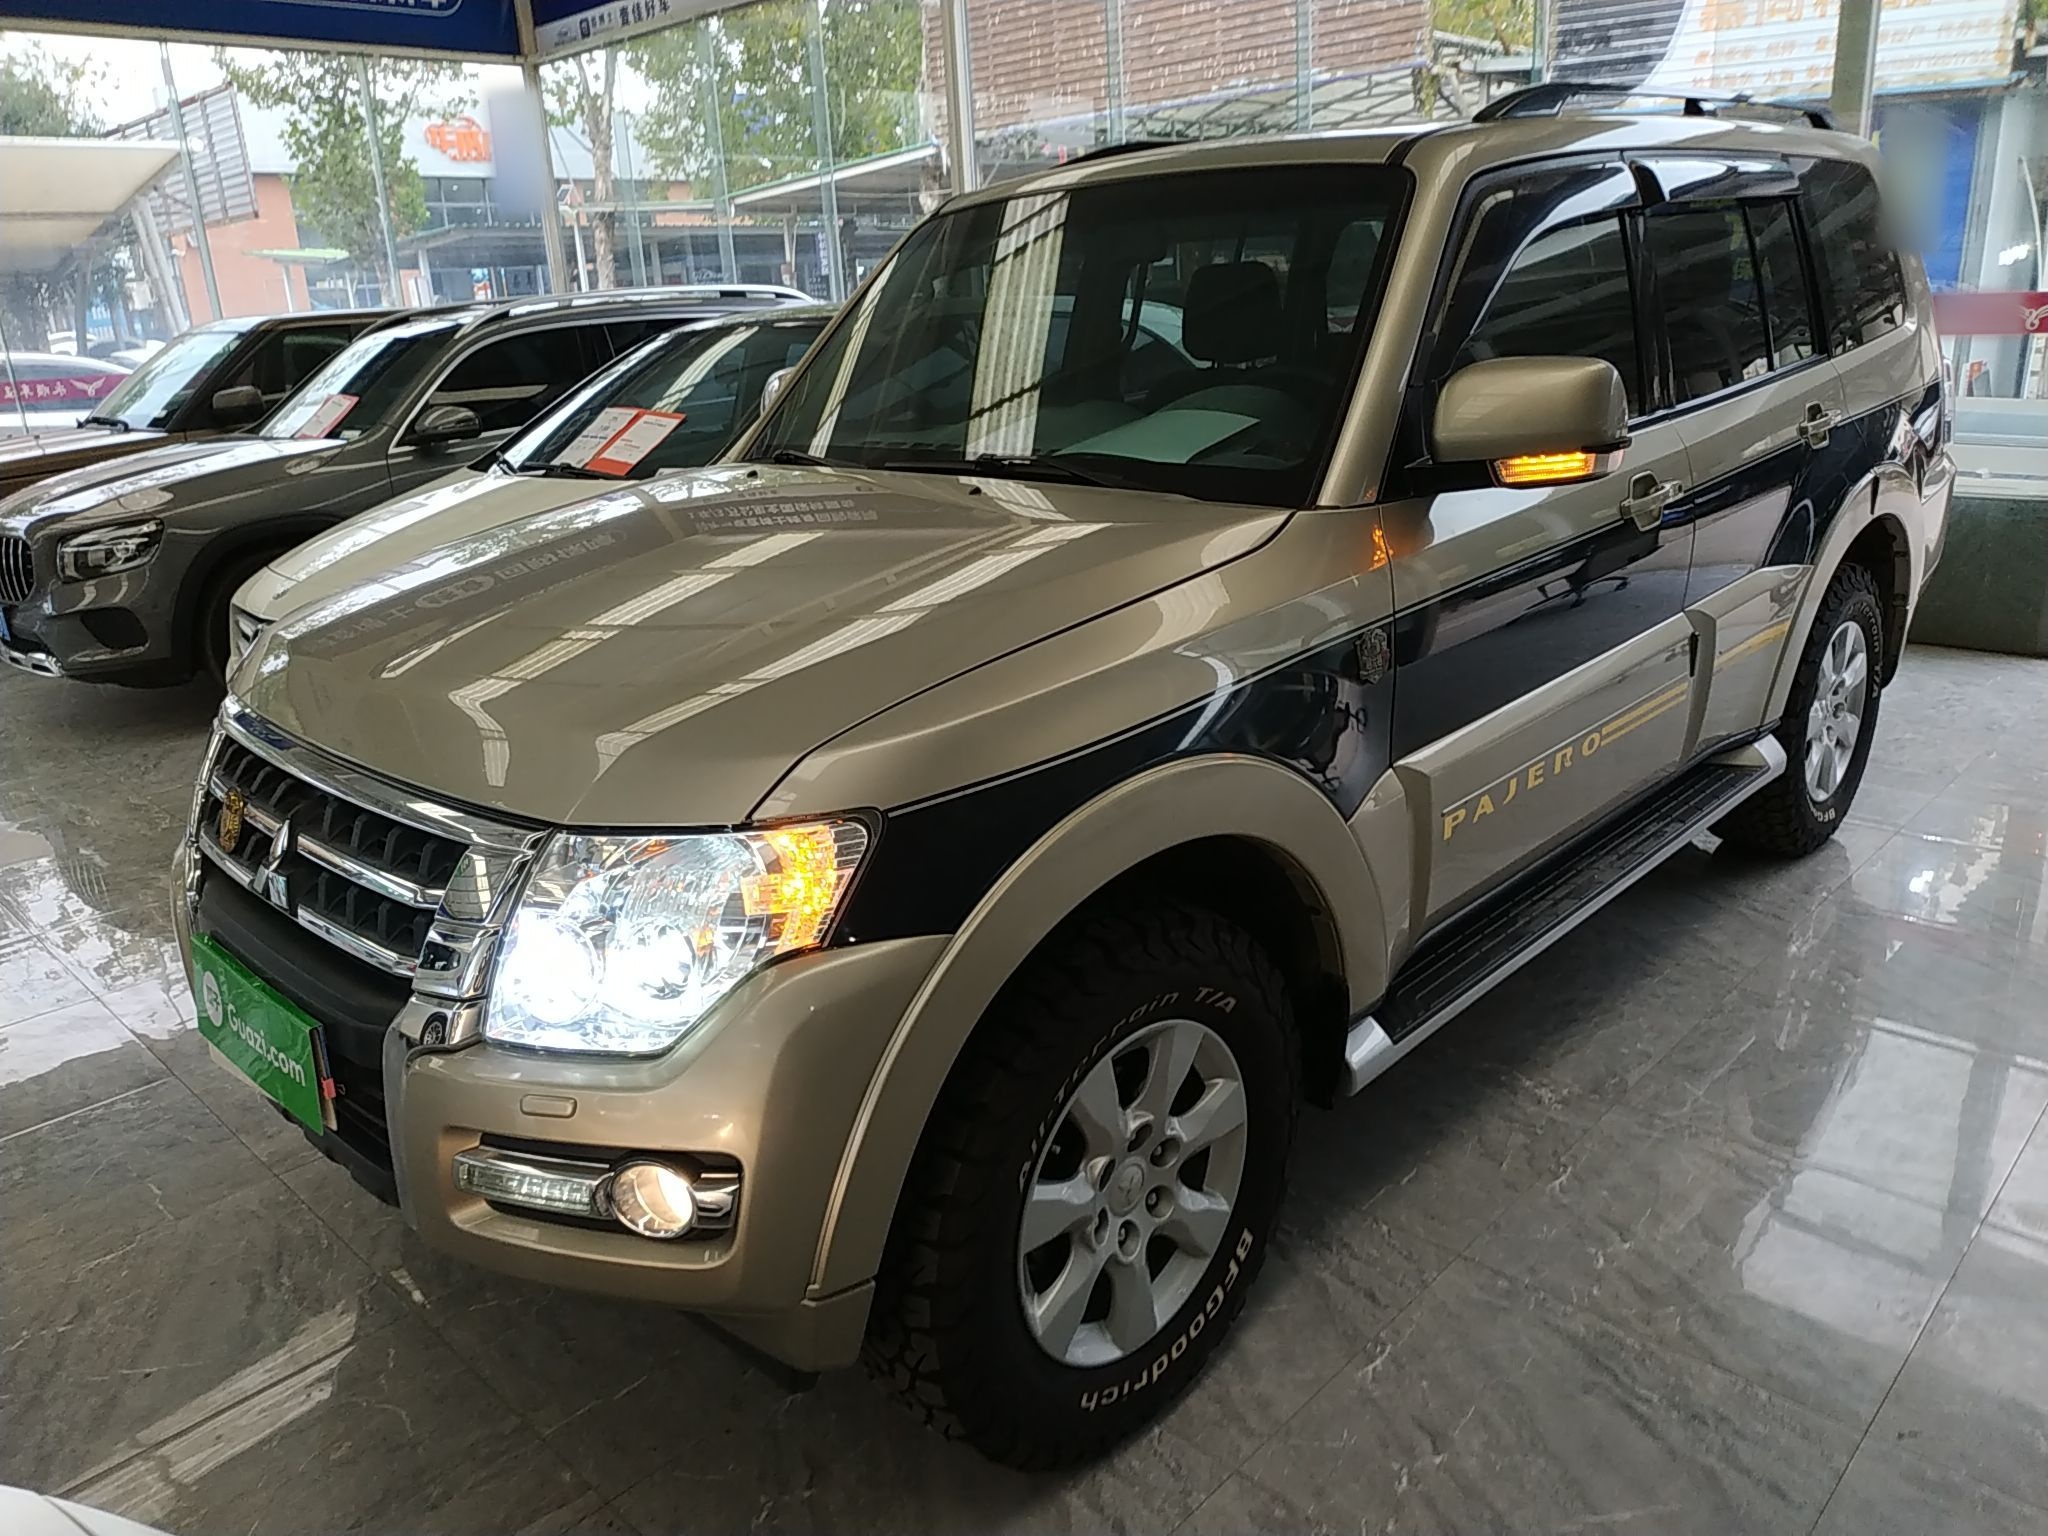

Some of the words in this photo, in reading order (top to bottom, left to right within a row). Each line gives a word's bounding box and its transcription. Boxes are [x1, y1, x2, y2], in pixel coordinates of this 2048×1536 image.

[1443, 731, 1601, 841] PAJERO
[226, 1004, 306, 1088] Guazi.com
[1194, 986, 1239, 1014] T/A
[1080, 1227, 1254, 1412] BFGoodrich
